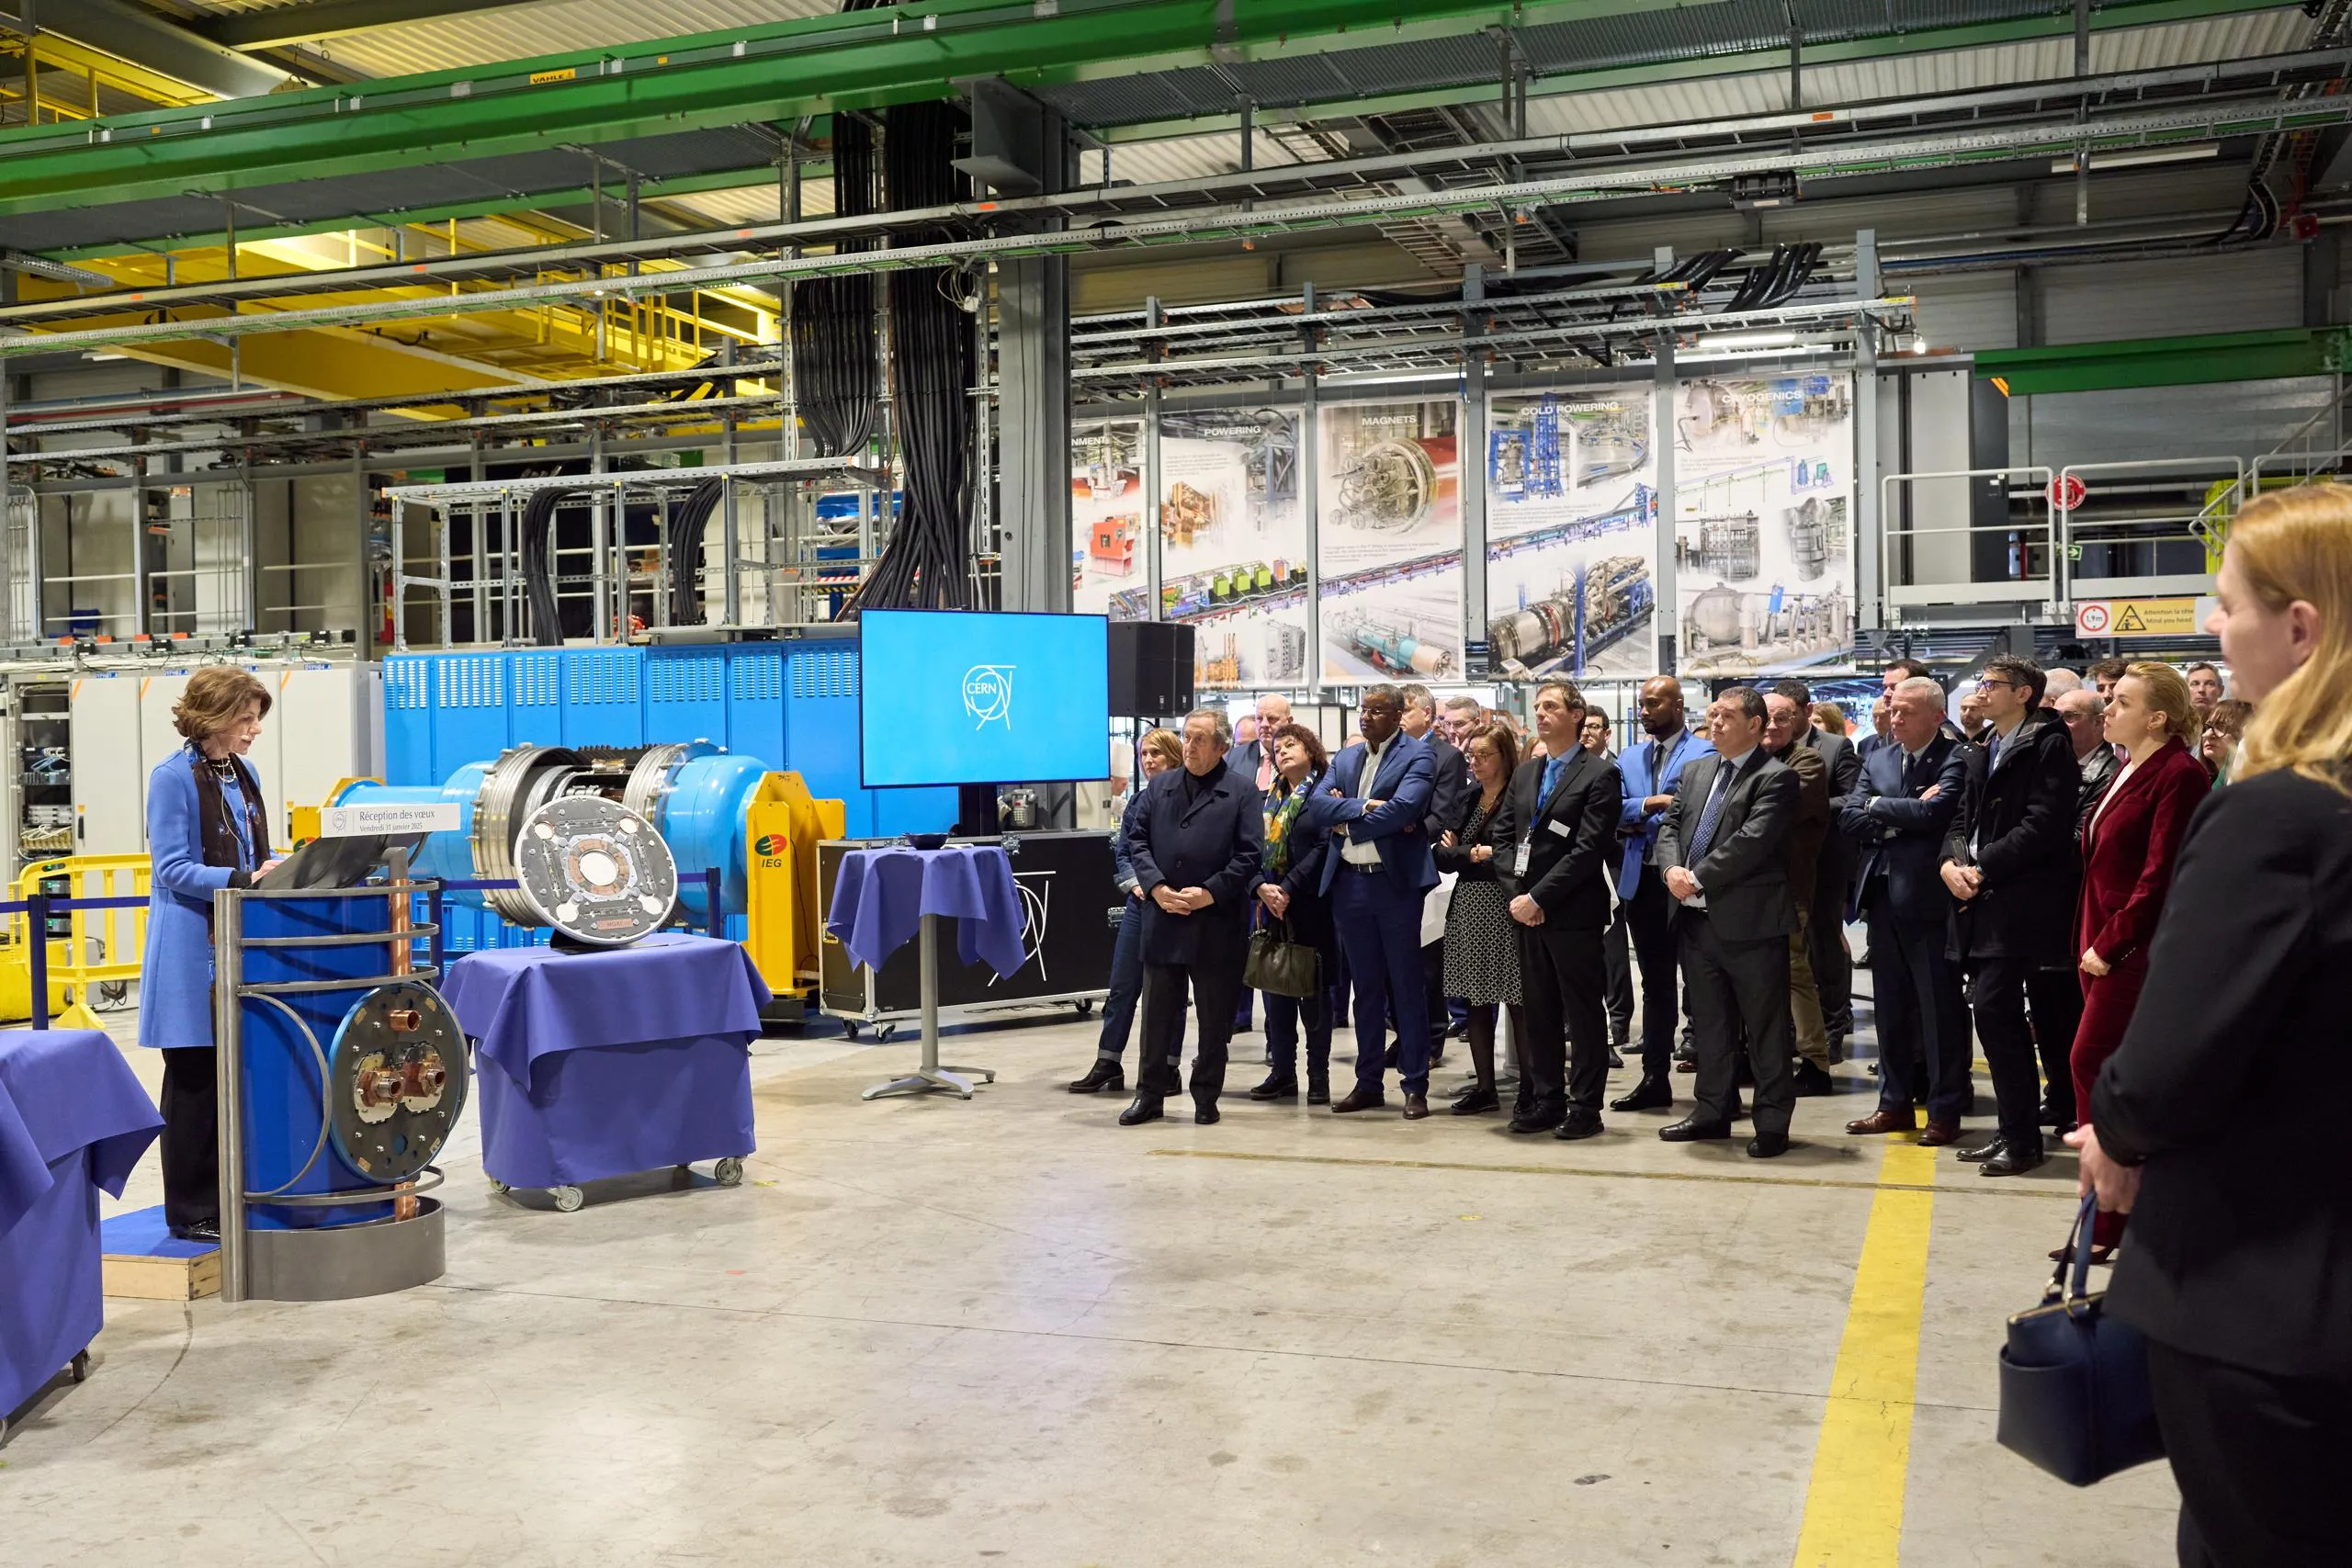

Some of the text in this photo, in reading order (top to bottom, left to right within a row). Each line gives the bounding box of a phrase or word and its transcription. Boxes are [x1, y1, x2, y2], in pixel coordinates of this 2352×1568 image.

[533, 73, 563, 84] VAHLE
[1521, 401, 1619, 415] COLD POWERING
[1362, 414, 1417, 426] MAGNETS
[1204, 425, 1261, 436] POWERING
[967, 682, 997, 694] CERN
[359, 809, 435, 823] Réception des vœux
[359, 824, 385, 832] Vendredi
[392, 823, 411, 832] janvier
[411, 822, 423, 830] 2025
[762, 858, 783, 868] IEG
